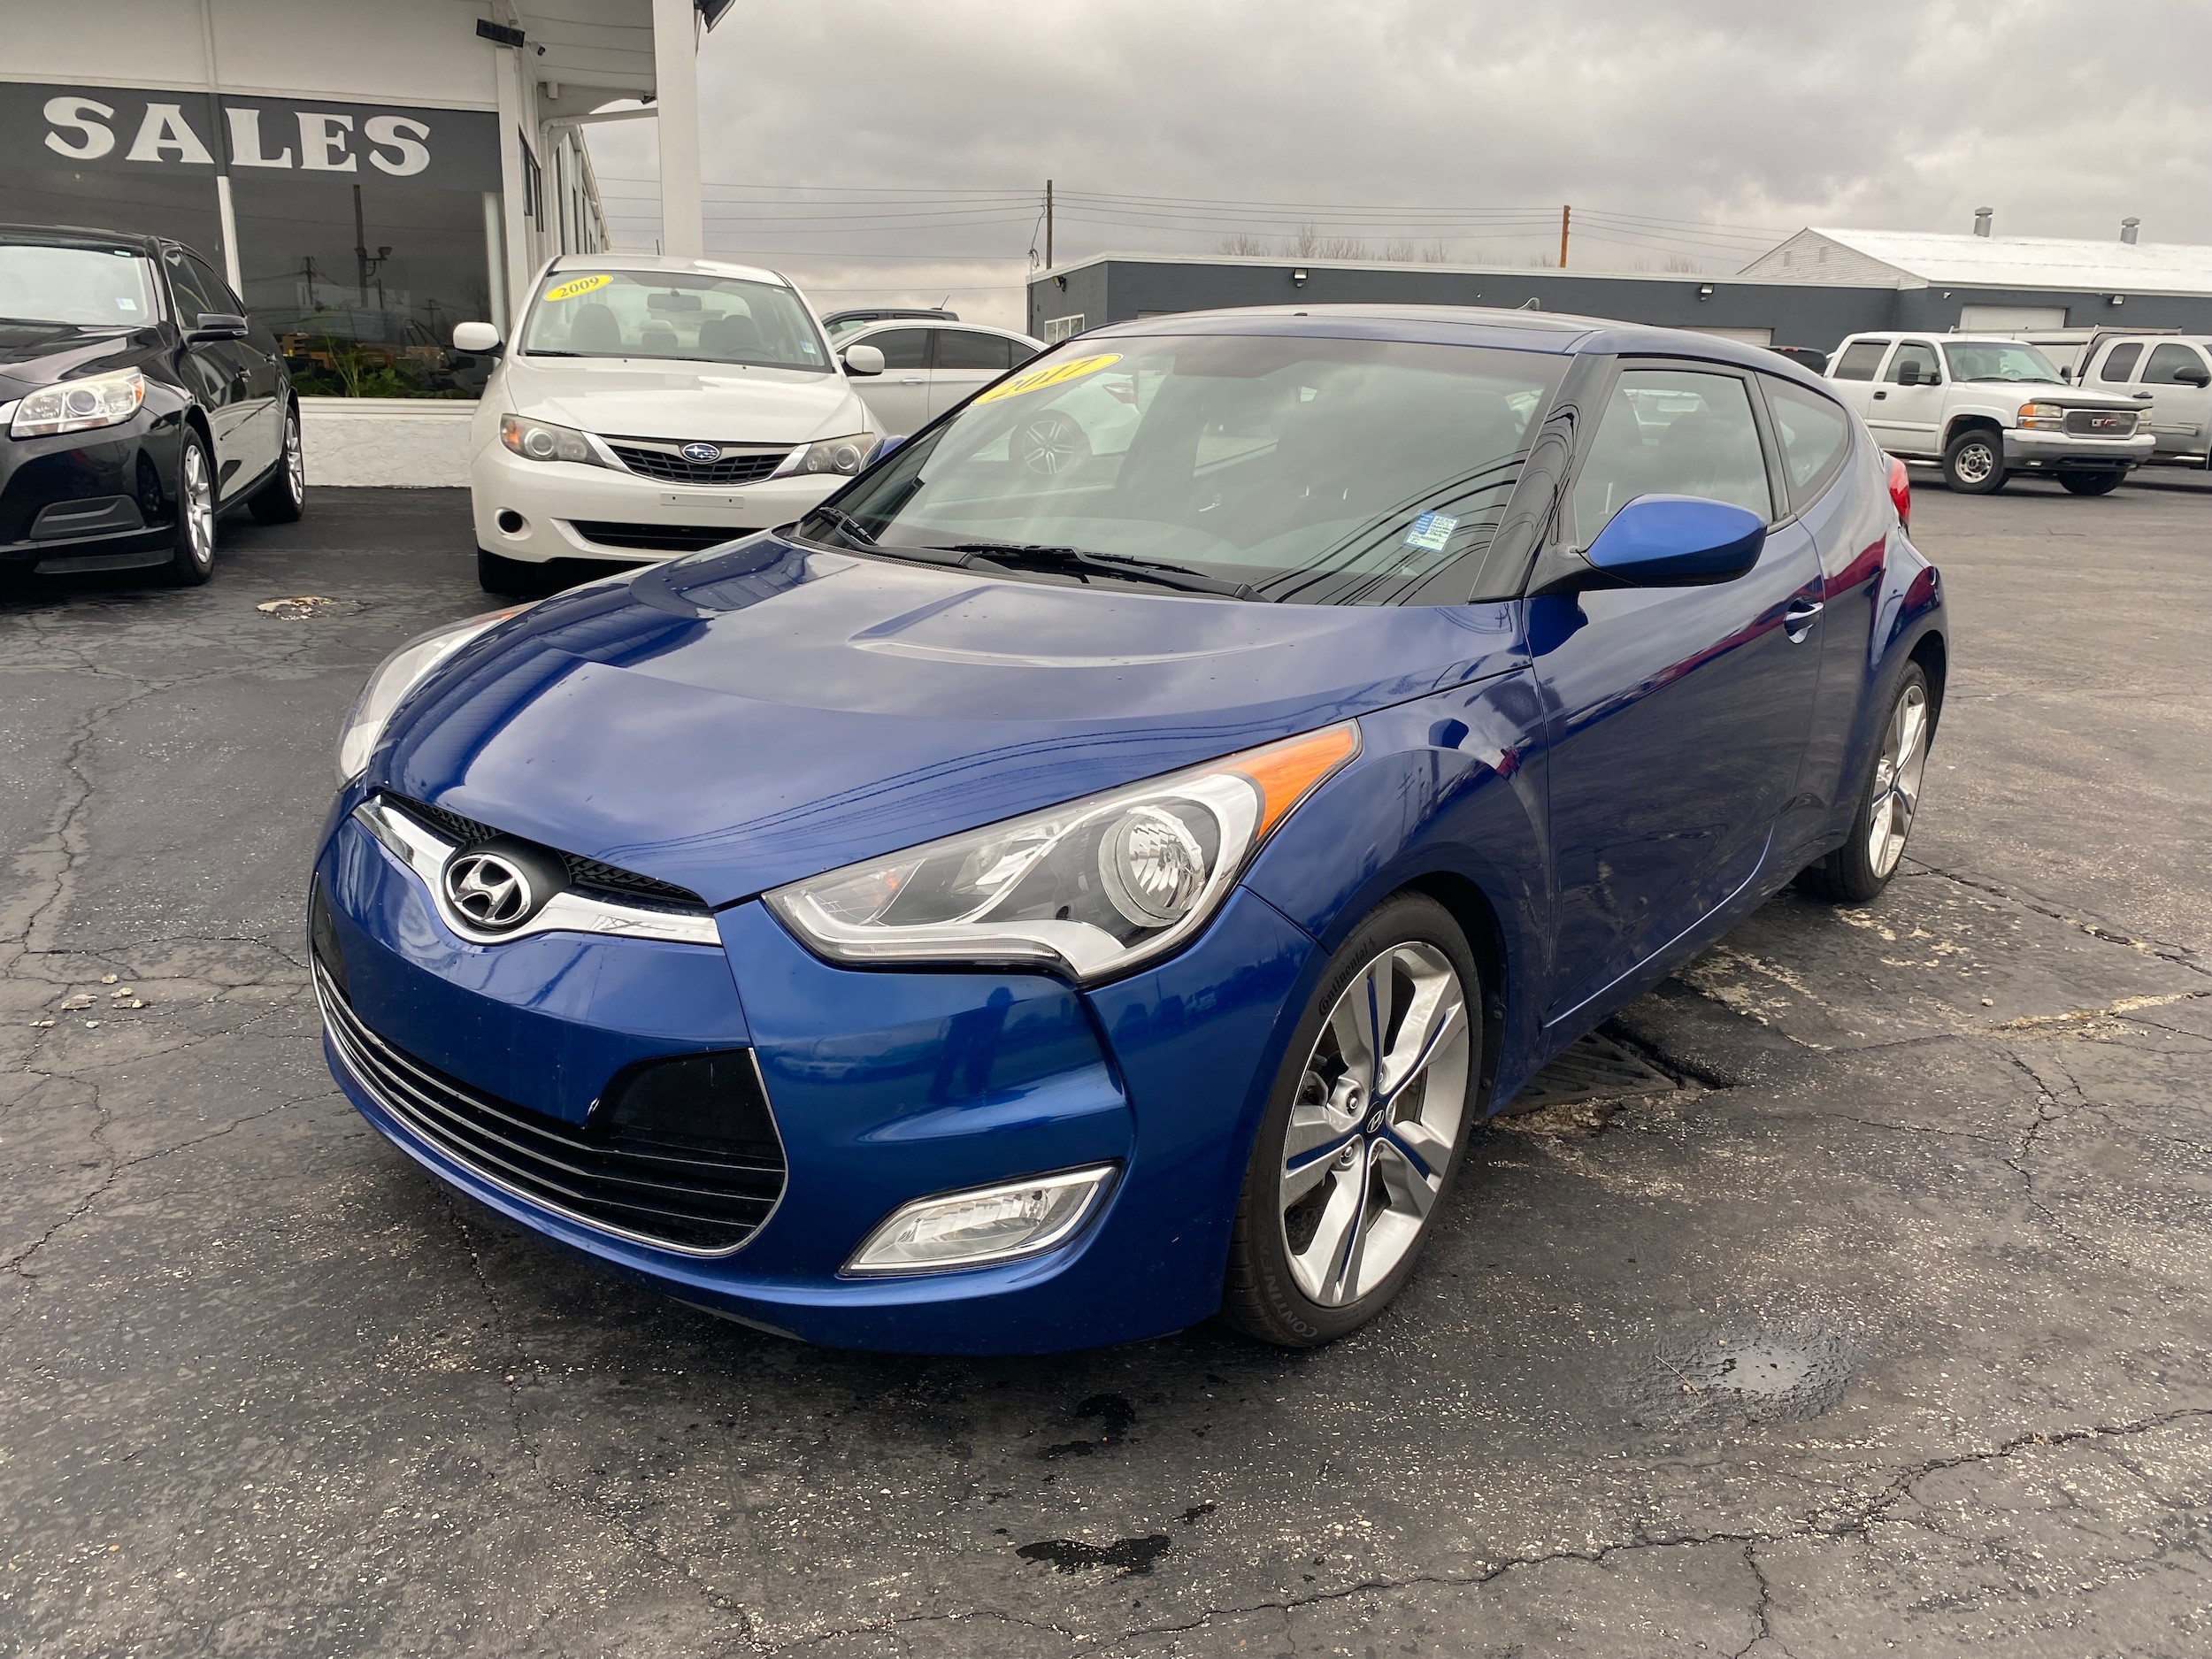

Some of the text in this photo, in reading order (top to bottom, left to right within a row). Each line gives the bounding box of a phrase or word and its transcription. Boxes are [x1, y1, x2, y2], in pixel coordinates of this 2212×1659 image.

[42, 96, 431, 176] SALES
[558, 276, 600, 298] 2009
[988, 357, 1102, 400] 2017
[1317, 941, 1370, 1018] Continental
